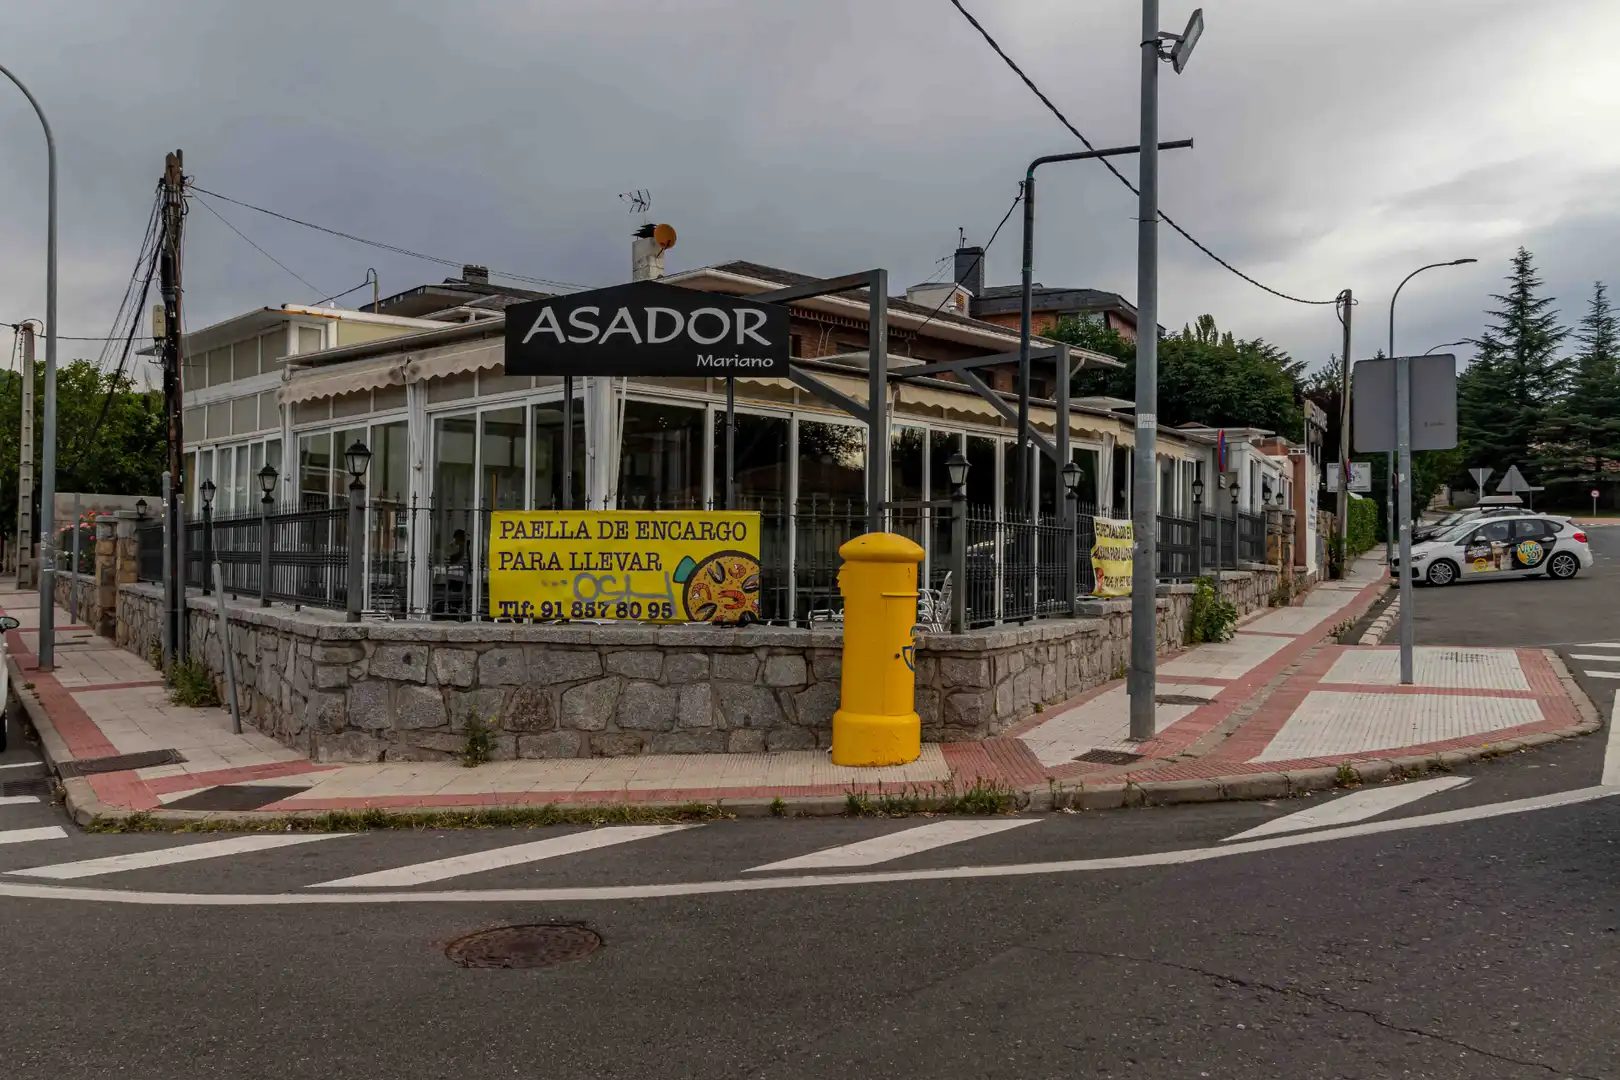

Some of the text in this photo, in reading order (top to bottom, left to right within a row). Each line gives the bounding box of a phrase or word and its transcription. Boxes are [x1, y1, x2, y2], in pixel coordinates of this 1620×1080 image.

[522, 305, 773, 346] ASADOR
[696, 353, 774, 368] Mariano
[498, 520, 747, 541] PAELLA DE ENCARGO
[498, 551, 663, 571] PARA LLEVAR
[498, 601, 673, 619] Tlf: 91 857 80 95
